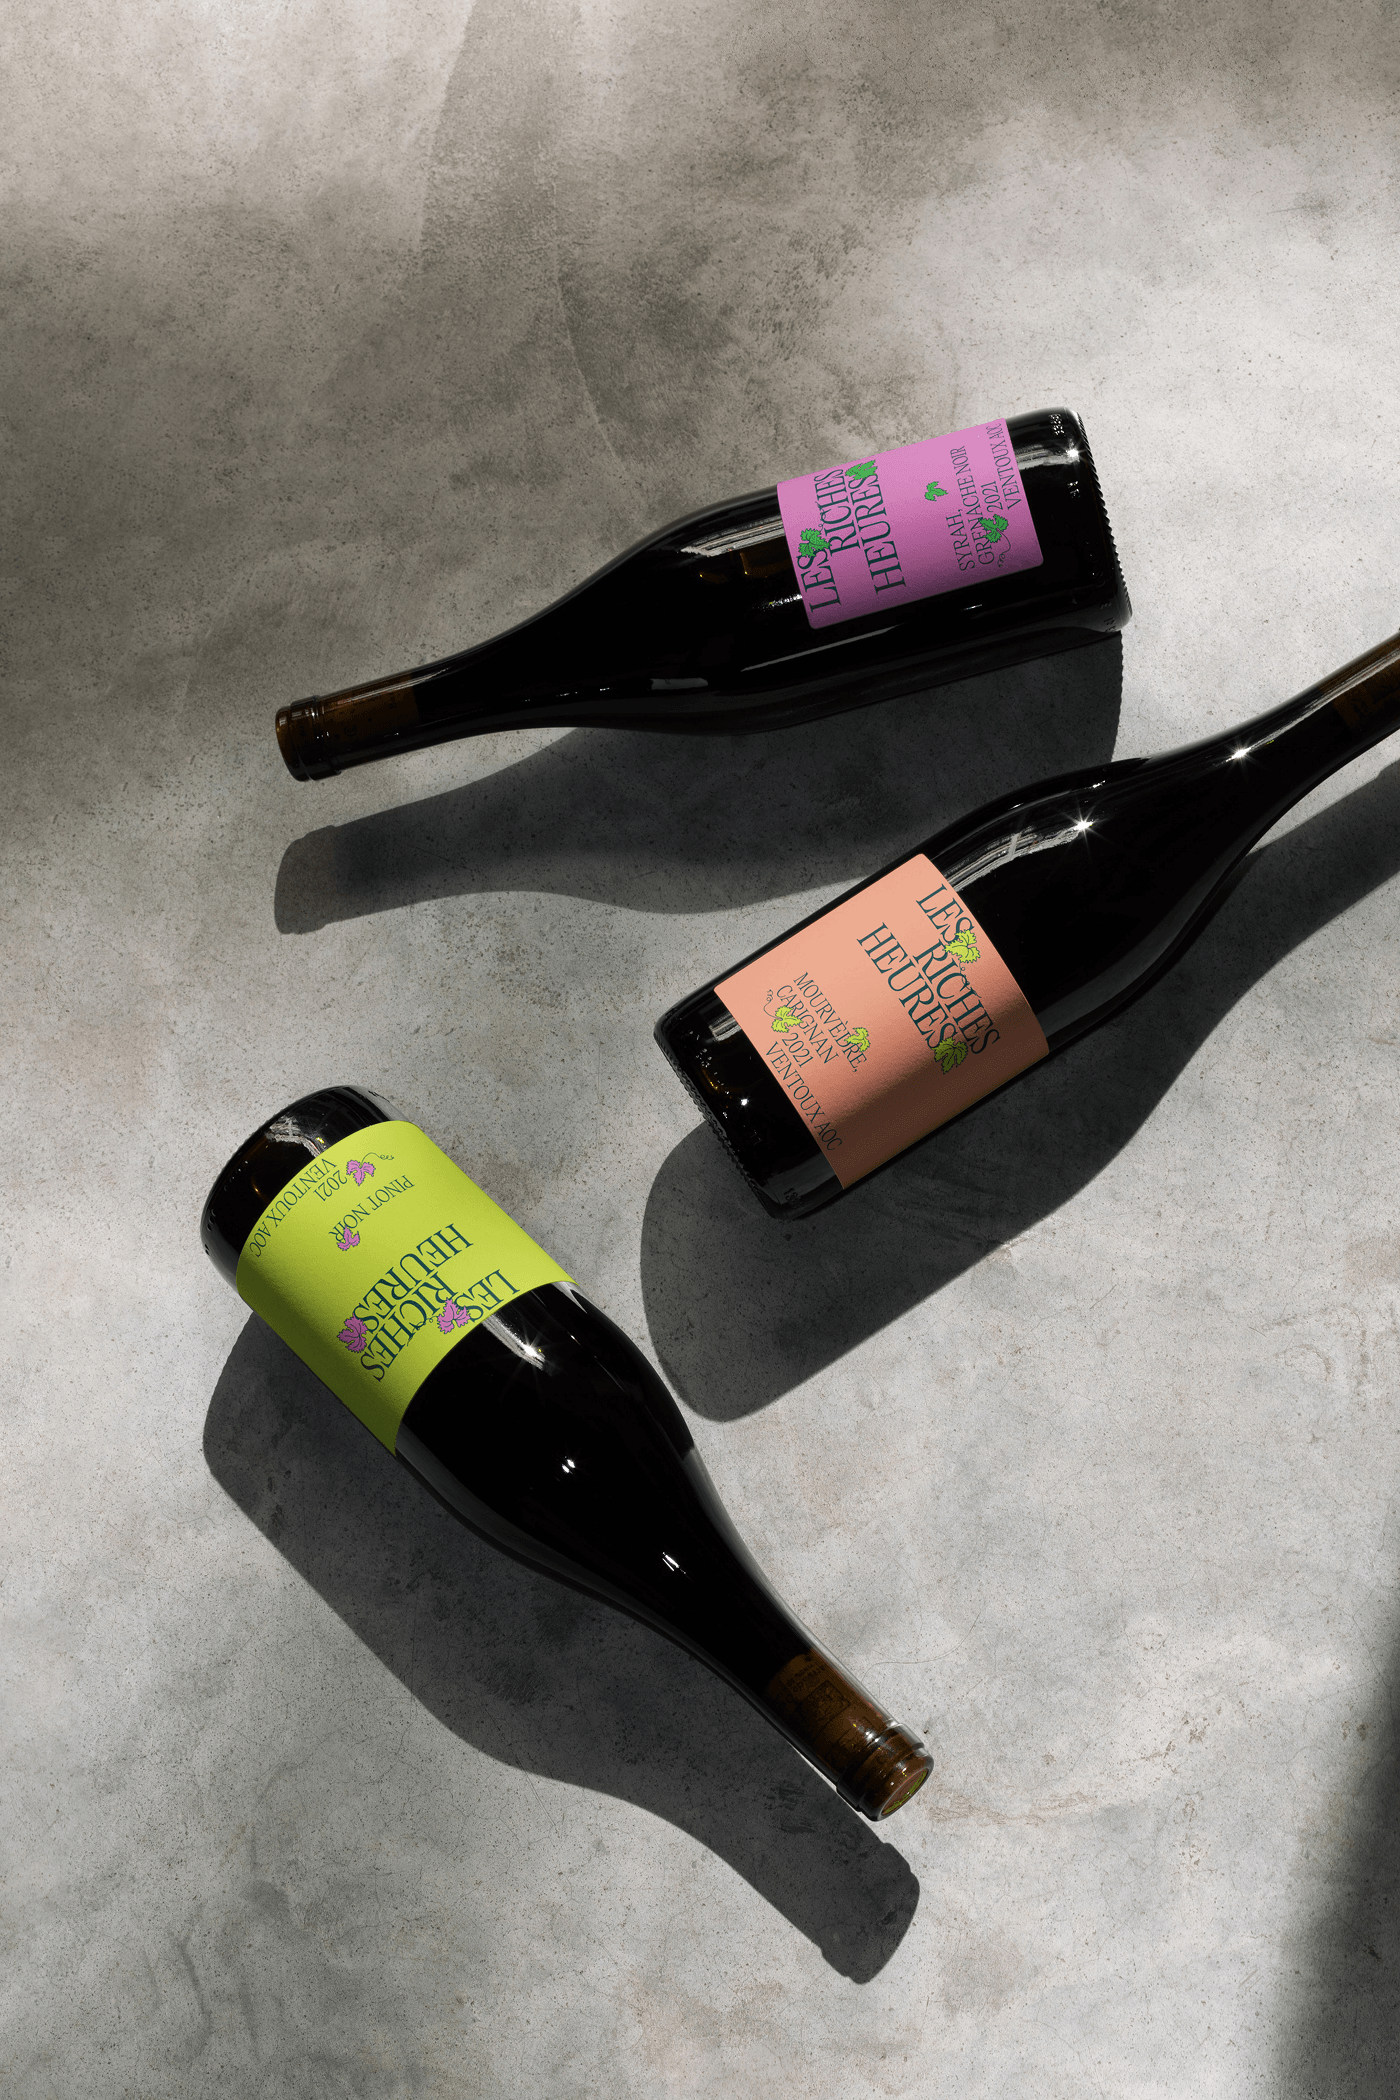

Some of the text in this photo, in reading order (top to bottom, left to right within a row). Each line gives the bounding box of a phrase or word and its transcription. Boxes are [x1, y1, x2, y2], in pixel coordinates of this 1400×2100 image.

[950, 445, 995, 565] GRENACHE NOIR
[981, 481, 1004, 513] 2021
[985, 423, 1022, 510] VENTOUX AOC
[814, 469, 861, 557] RICHES
[848, 473, 907, 594] HEURES
[946, 508, 975, 571] SYRAH,
[797, 548, 841, 613] LES
[916, 883, 975, 943] LES
[776, 985, 839, 1064] CARIGNAN
[793, 971, 868, 1073] MOURVÈDRE,
[856, 922, 959, 1050] HEURES
[912, 938, 1001, 1055] RICHES
[782, 1032, 814, 1068] 2021
[766, 1041, 843, 1151] VENTOUX AOC
[250, 1158, 337, 1258] VENTOUX AOC
[313, 1170, 348, 1202] 2021
[328, 1175, 415, 1242] PINOT NOIR
[352, 1223, 474, 1334] HEURES
[455, 1269, 520, 1323] LES
[360, 1271, 459, 1382] RICHES
